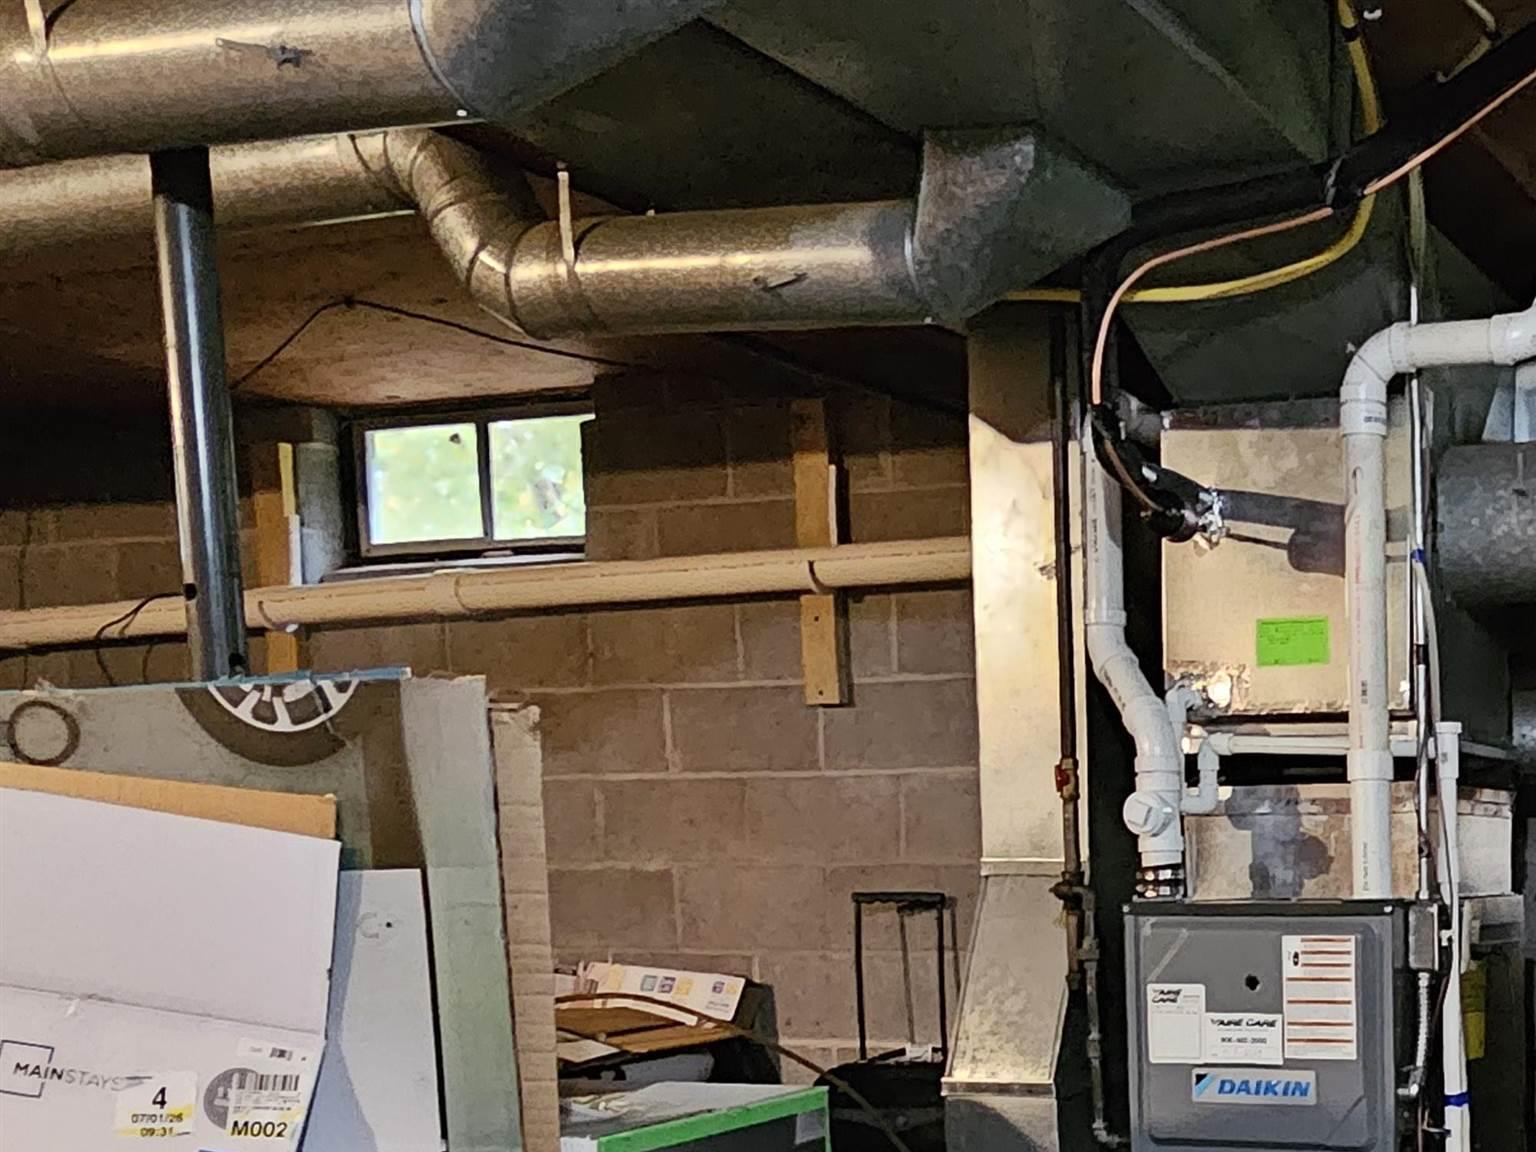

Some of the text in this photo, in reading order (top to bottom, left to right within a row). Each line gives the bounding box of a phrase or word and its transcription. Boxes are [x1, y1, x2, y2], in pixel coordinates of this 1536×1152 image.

[13, 1060, 122, 1092] MAINSTAYS
[151, 1086, 168, 1110] 4
[1217, 1079, 1311, 1097] DAIKIN
[230, 1120, 289, 1139] M002
